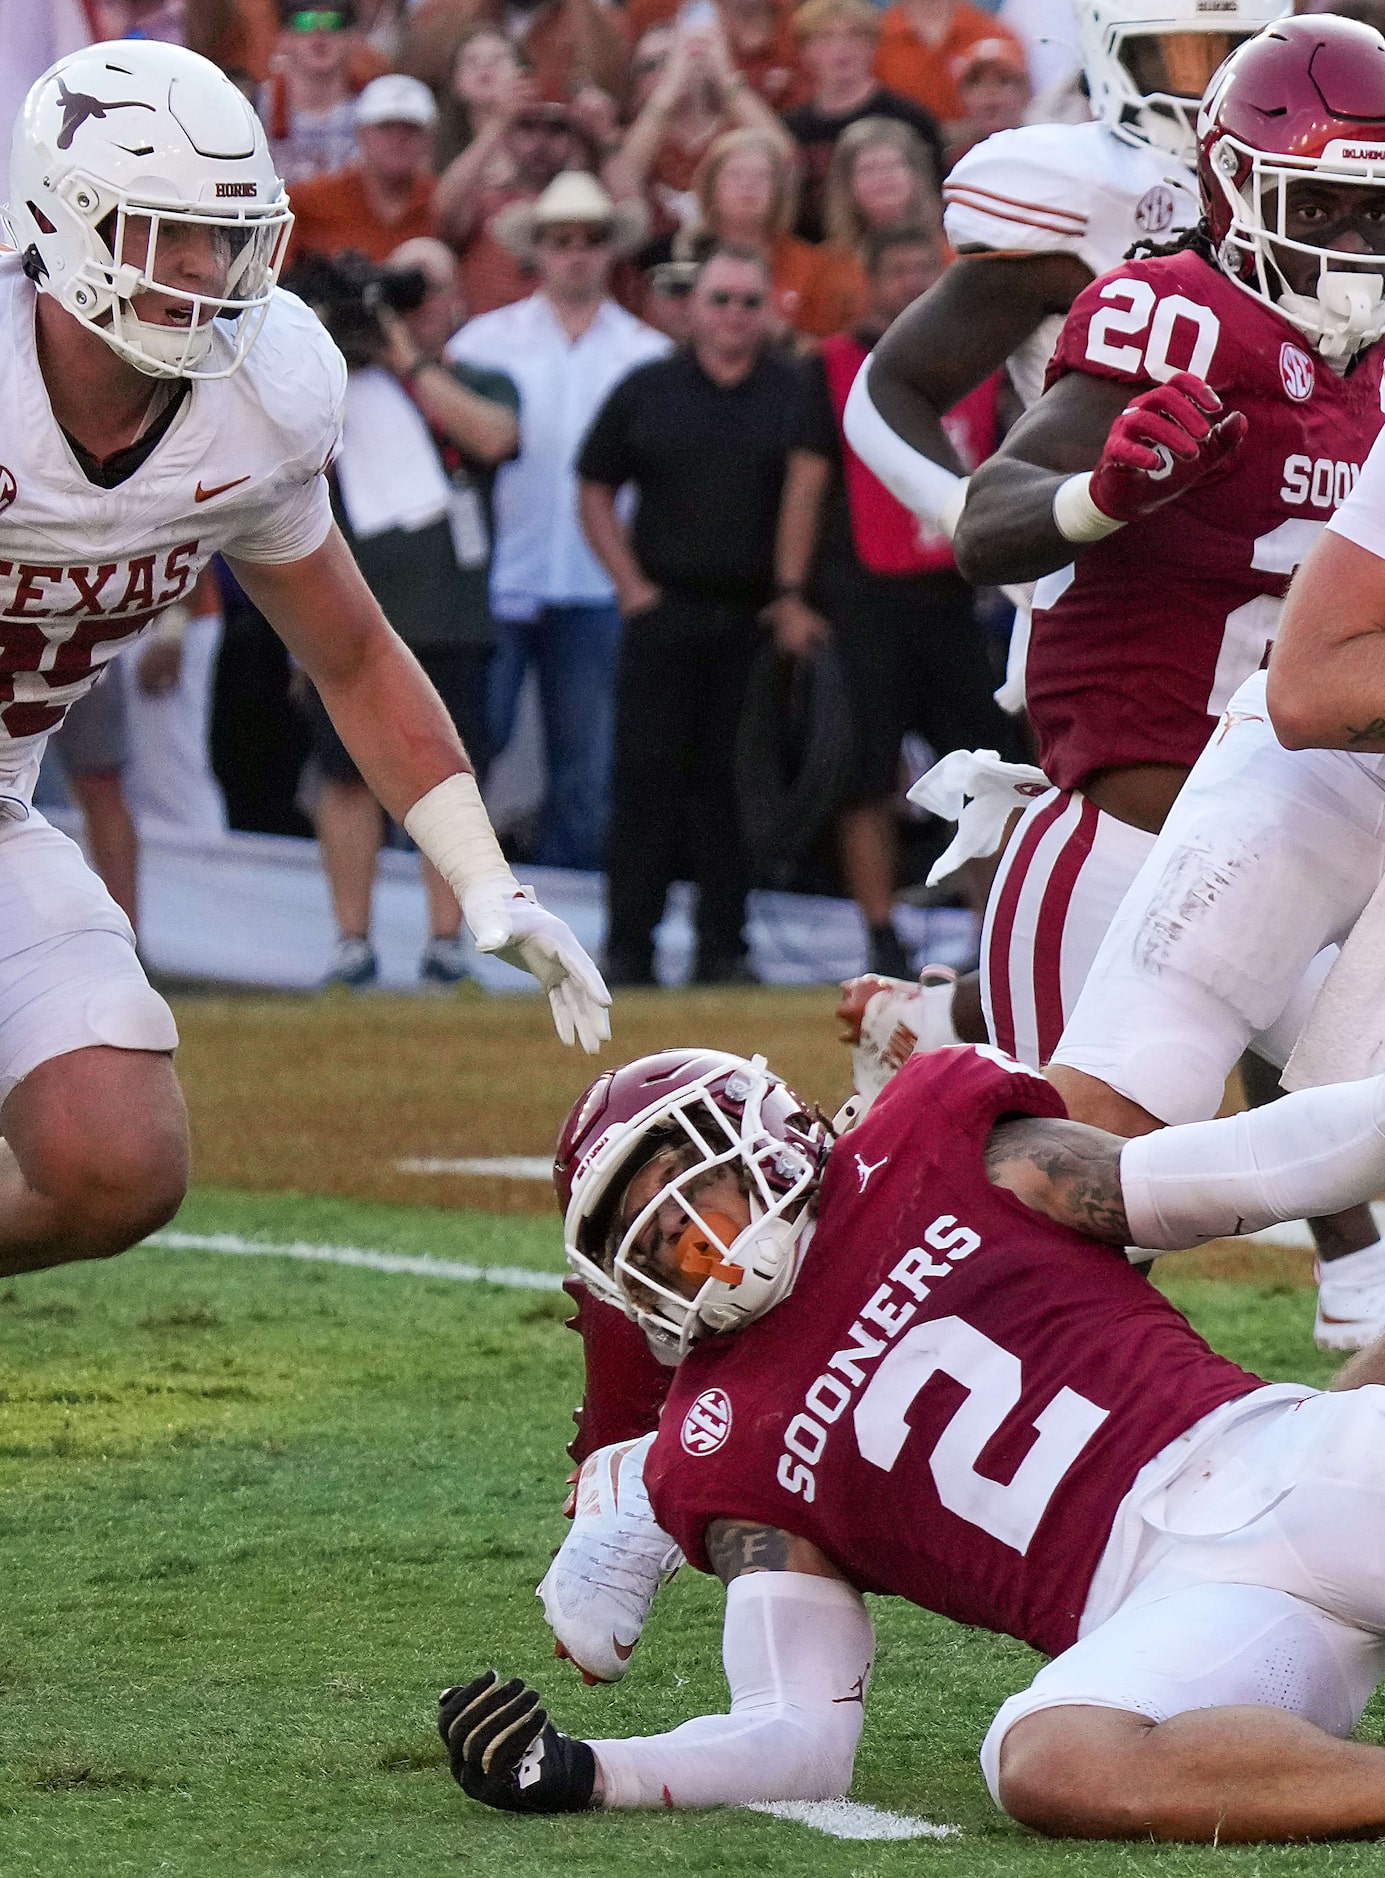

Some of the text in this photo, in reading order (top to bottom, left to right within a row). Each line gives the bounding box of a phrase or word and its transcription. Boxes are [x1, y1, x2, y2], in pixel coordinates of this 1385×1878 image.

[1085, 281, 1220, 384] 20
[1280, 342, 1315, 402] SEC
[0, 539, 200, 617] EXAS
[776, 1214, 982, 1504] SOONERS
[680, 1387, 734, 1457] SEC
[853, 1314, 1112, 1558] 2
